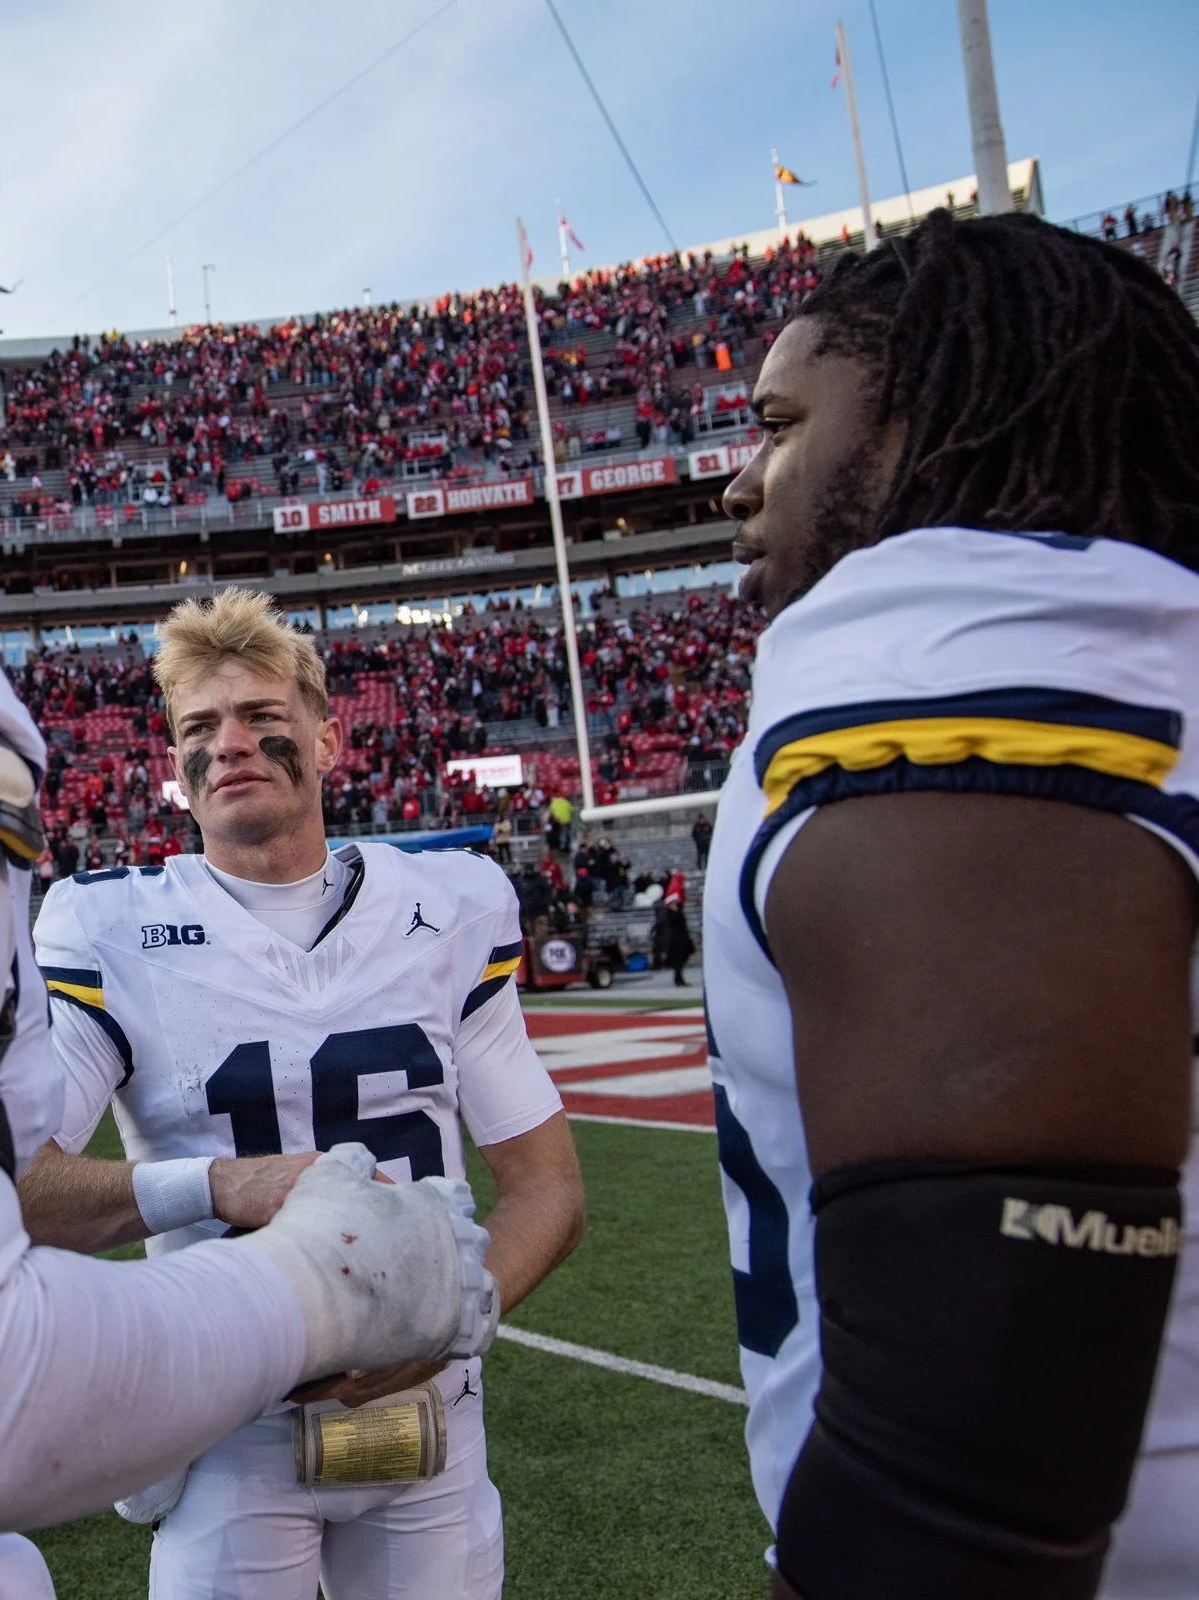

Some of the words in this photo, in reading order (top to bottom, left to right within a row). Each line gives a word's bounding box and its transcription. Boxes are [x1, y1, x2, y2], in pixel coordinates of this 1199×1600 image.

[590, 460, 665, 489] GEORGE
[413, 496, 438, 513] 22
[447, 481, 528, 509] HORVATH
[280, 510, 303, 527] 10
[318, 500, 382, 524] SMITH
[205, 1023, 444, 1184] 16
